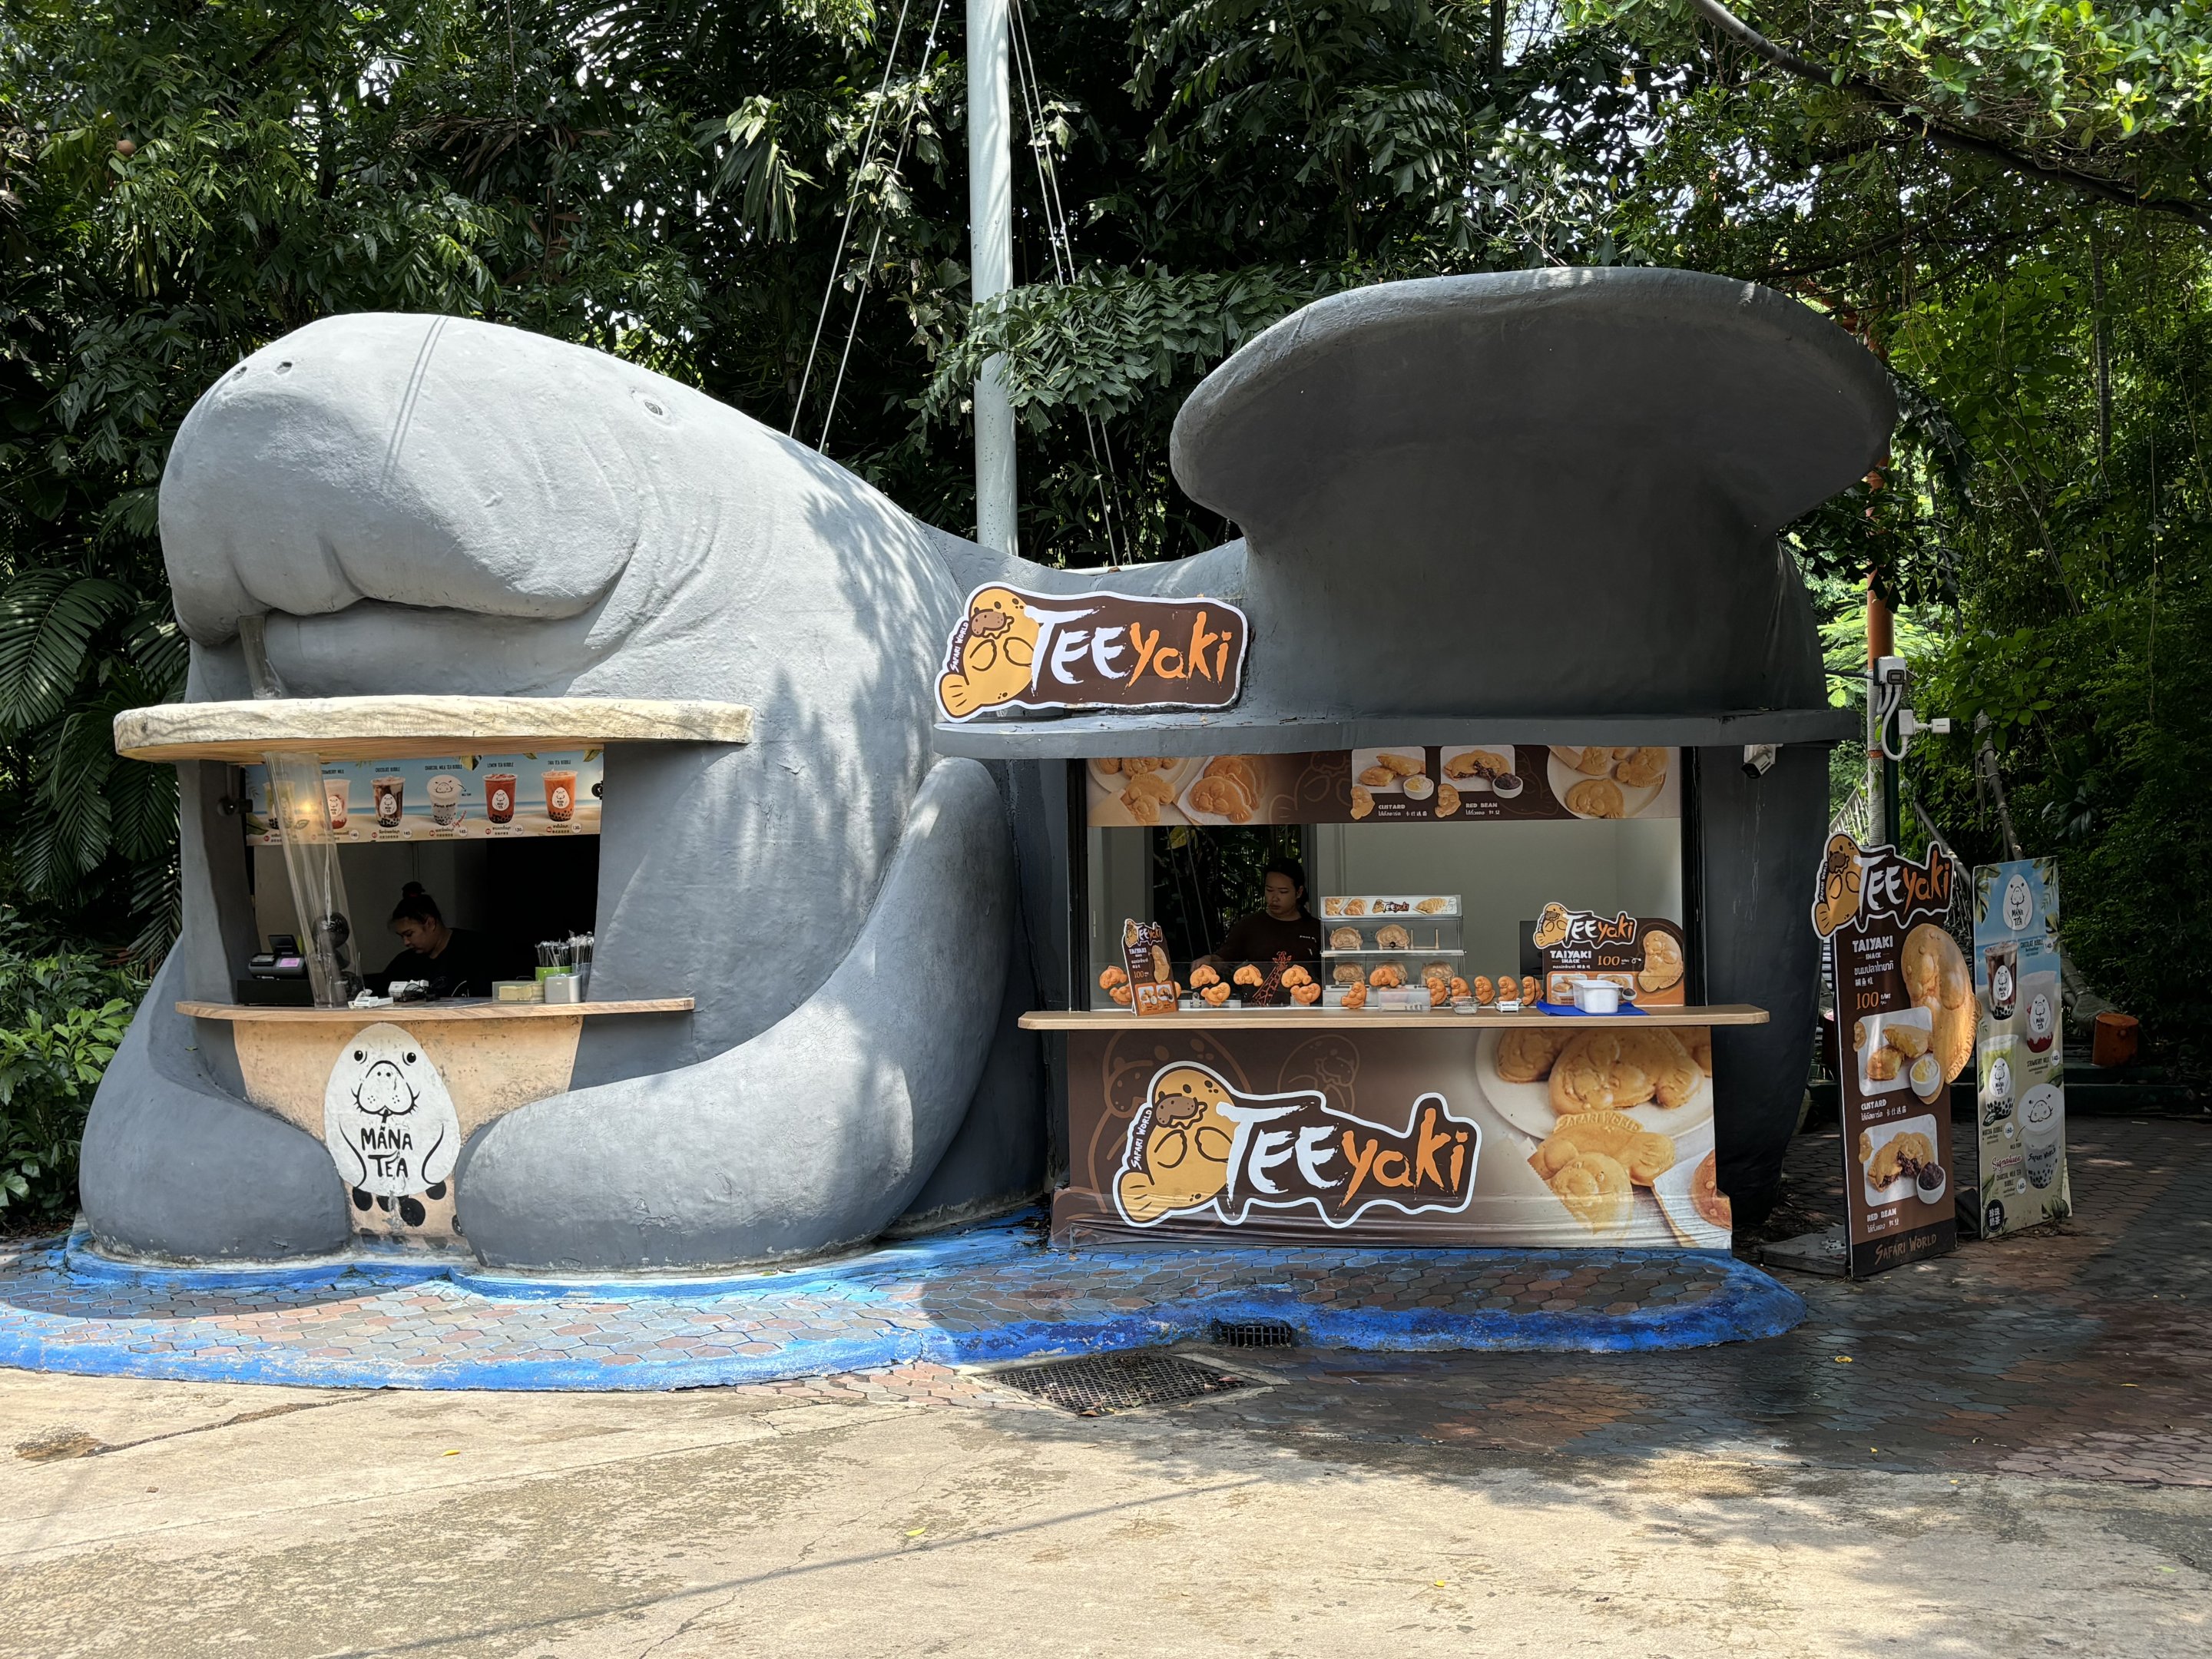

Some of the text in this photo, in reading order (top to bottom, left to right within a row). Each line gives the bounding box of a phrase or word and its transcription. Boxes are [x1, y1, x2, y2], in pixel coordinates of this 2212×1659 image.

[949, 621, 969, 674] SAFARI WORLD
[1852, 935, 1893, 953] TAIYAKI
[1550, 950, 1592, 959] TAIYAKI
[1598, 955, 1620, 966] 100
[1856, 992, 1879, 1010] 100
[1860, 1098, 1887, 1111] CUSTARD
[1131, 1109, 1152, 1171] SAFARI WORLD
[367, 1151, 409, 1178] TEA
[1866, 1207, 1897, 1222] RED BEAN
[1874, 1234, 1937, 1265] SAFARI WORLD
